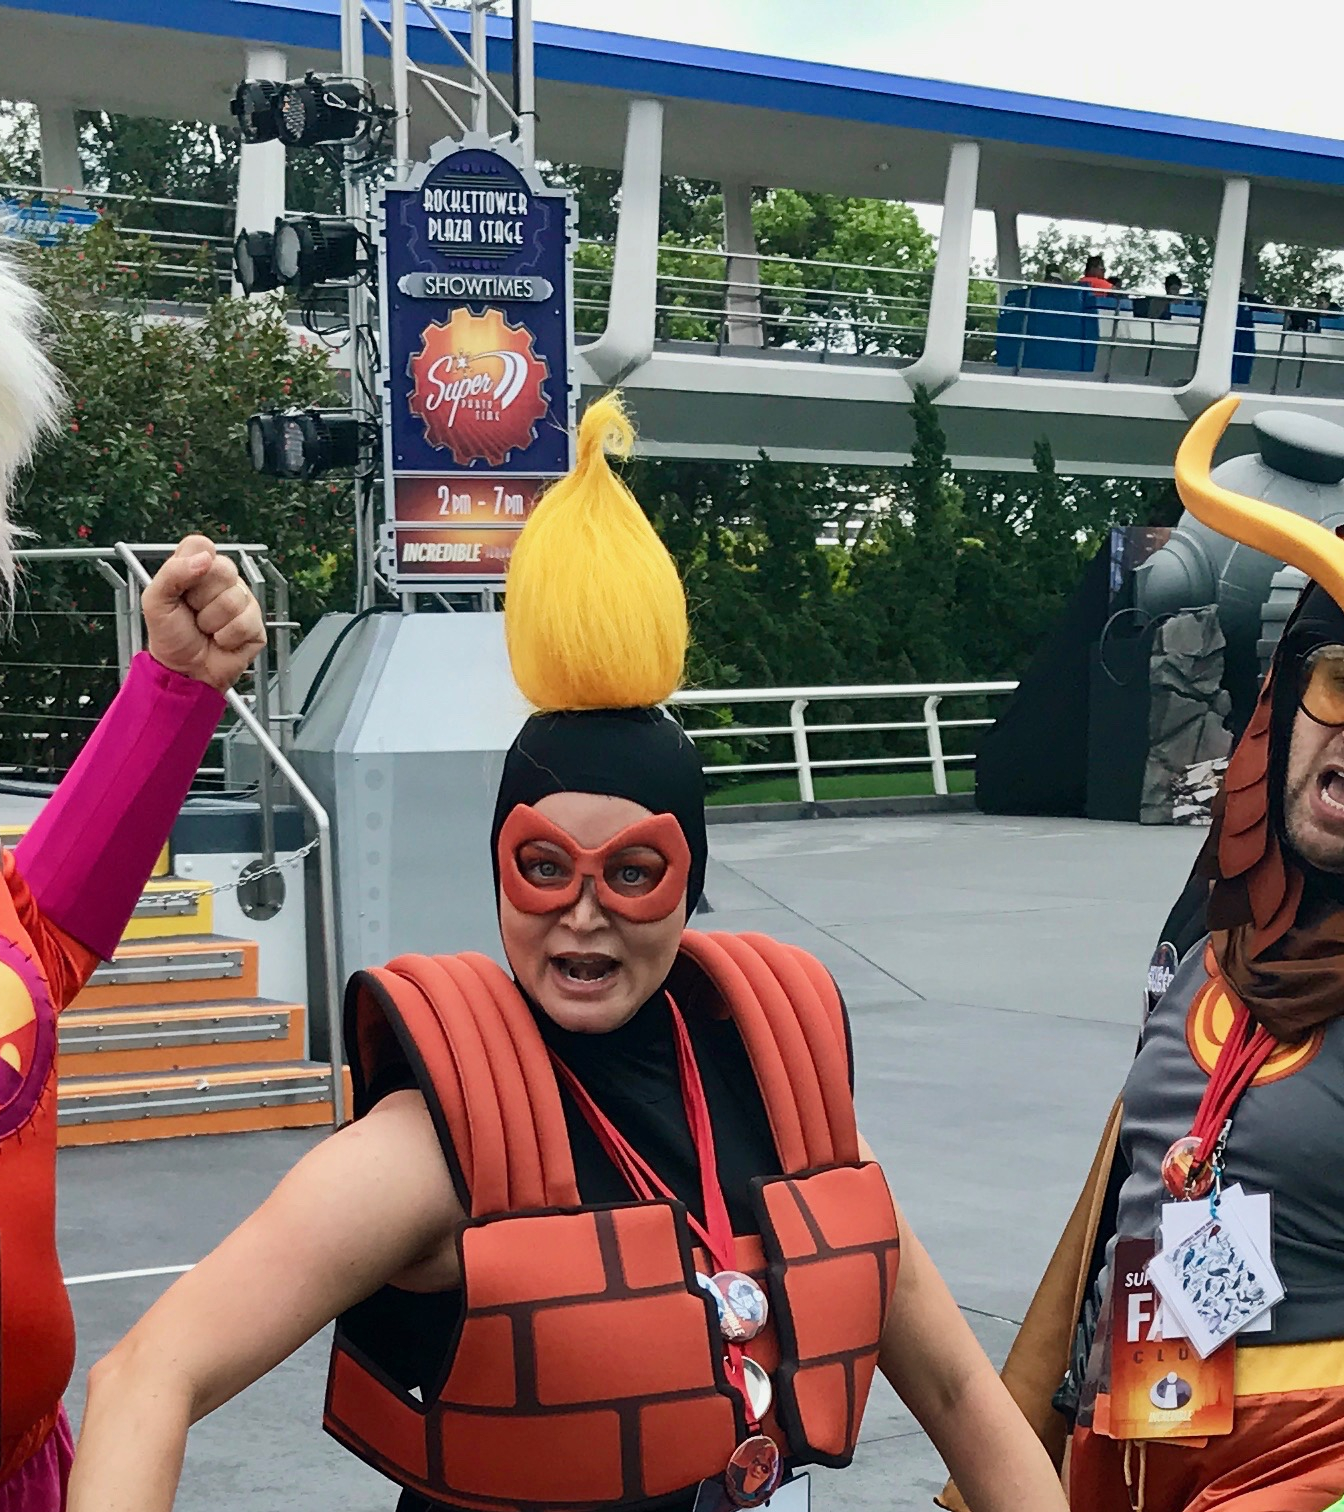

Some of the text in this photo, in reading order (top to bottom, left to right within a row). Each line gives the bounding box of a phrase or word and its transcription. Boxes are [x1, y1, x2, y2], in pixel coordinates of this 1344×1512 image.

[423, 188, 528, 215] ROCKETTOWER
[428, 217, 524, 244] PLAZA STAGE
[425, 276, 534, 297] SHOWTIMES
[426, 355, 494, 427] Super
[402, 542, 483, 562] INCREDIBLE
[1133, 1348, 1189, 1364] CLU
